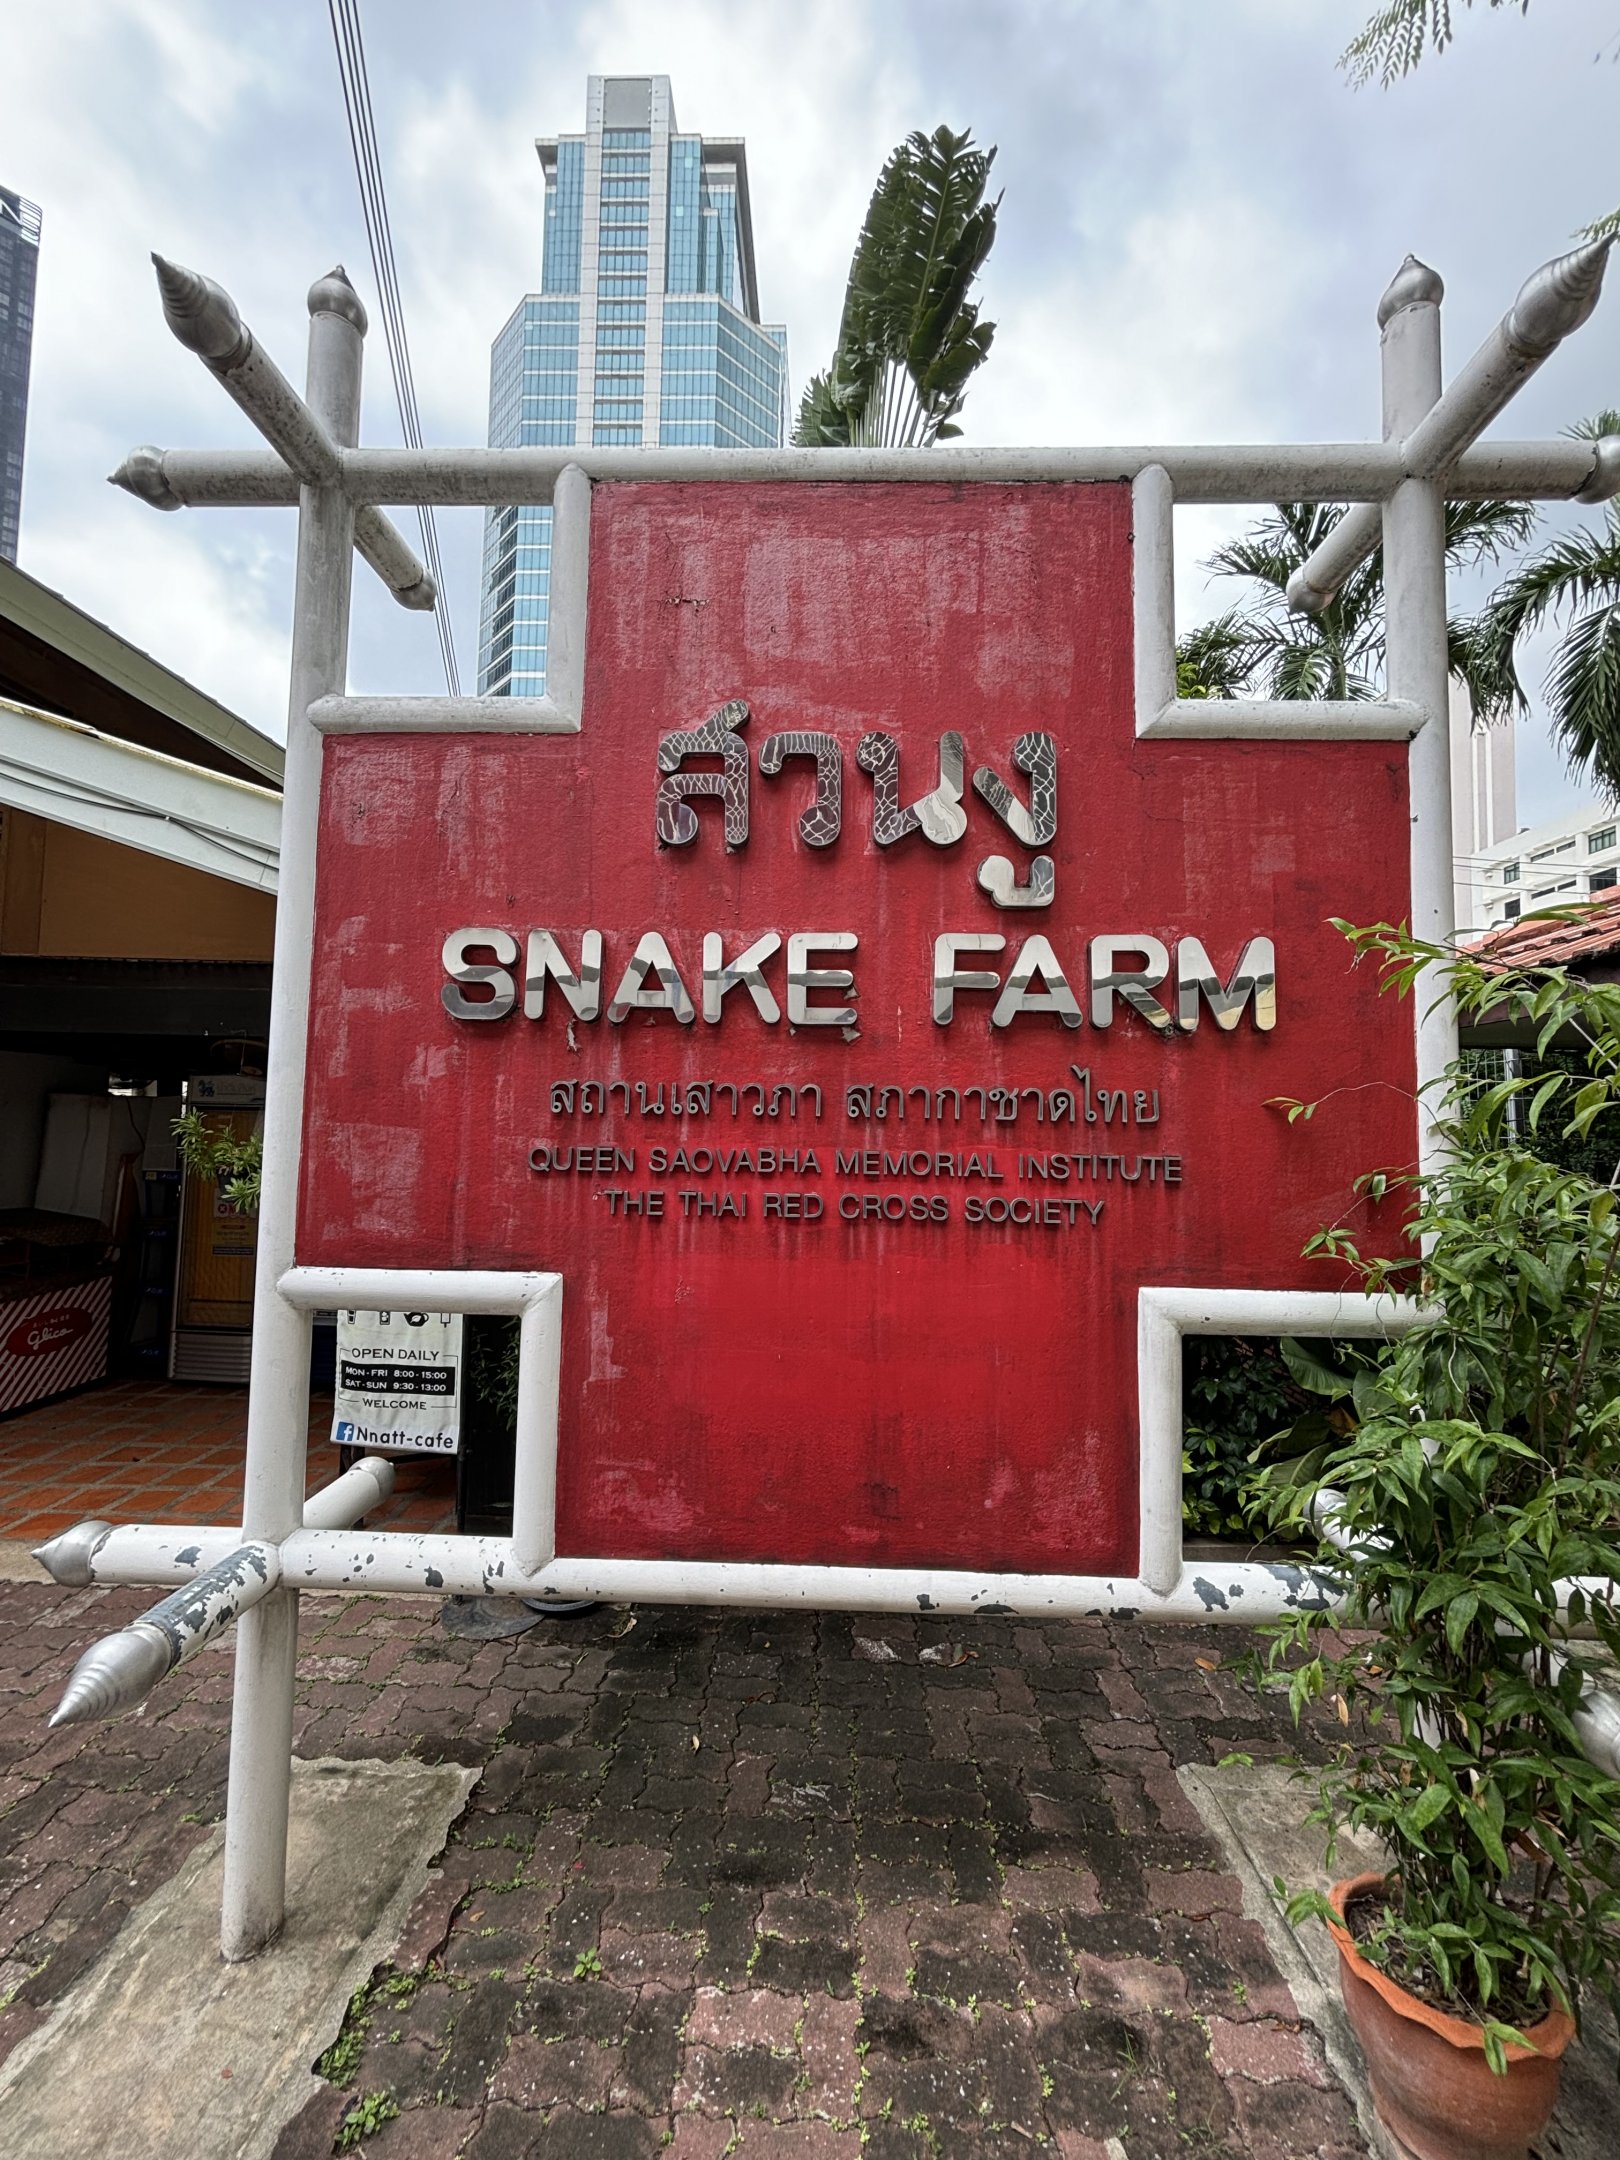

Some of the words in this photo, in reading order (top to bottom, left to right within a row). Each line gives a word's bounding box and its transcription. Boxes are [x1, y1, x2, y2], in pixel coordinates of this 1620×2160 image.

[656, 699, 1058, 908] สวนงู
[440, 927, 861, 1026] SNAKE
[932, 932, 1278, 1032] FARM
[550, 1078, 822, 1117] สถานเสาวภา
[847, 1064, 1160, 1124] สภากาชาดไทย
[528, 1146, 636, 1172] QUEEN
[648, 1147, 822, 1174] SAOVABHA
[834, 1149, 1004, 1178] MEMORIAL
[1018, 1153, 1183, 1182] INSTITUTE
[604, 1190, 665, 1216] THE
[678, 1191, 747, 1217] THAI
[763, 1192, 824, 1219] RED
[839, 1194, 949, 1221] CROSS
[964, 1196, 1105, 1225] SOCIETY
[351, 1348, 394, 1359] OPEN
[398, 1349, 440, 1361] DAILY
[362, 1398, 427, 1410] WELCOME
[356, 1426, 454, 1449] Nnatt-cafe
